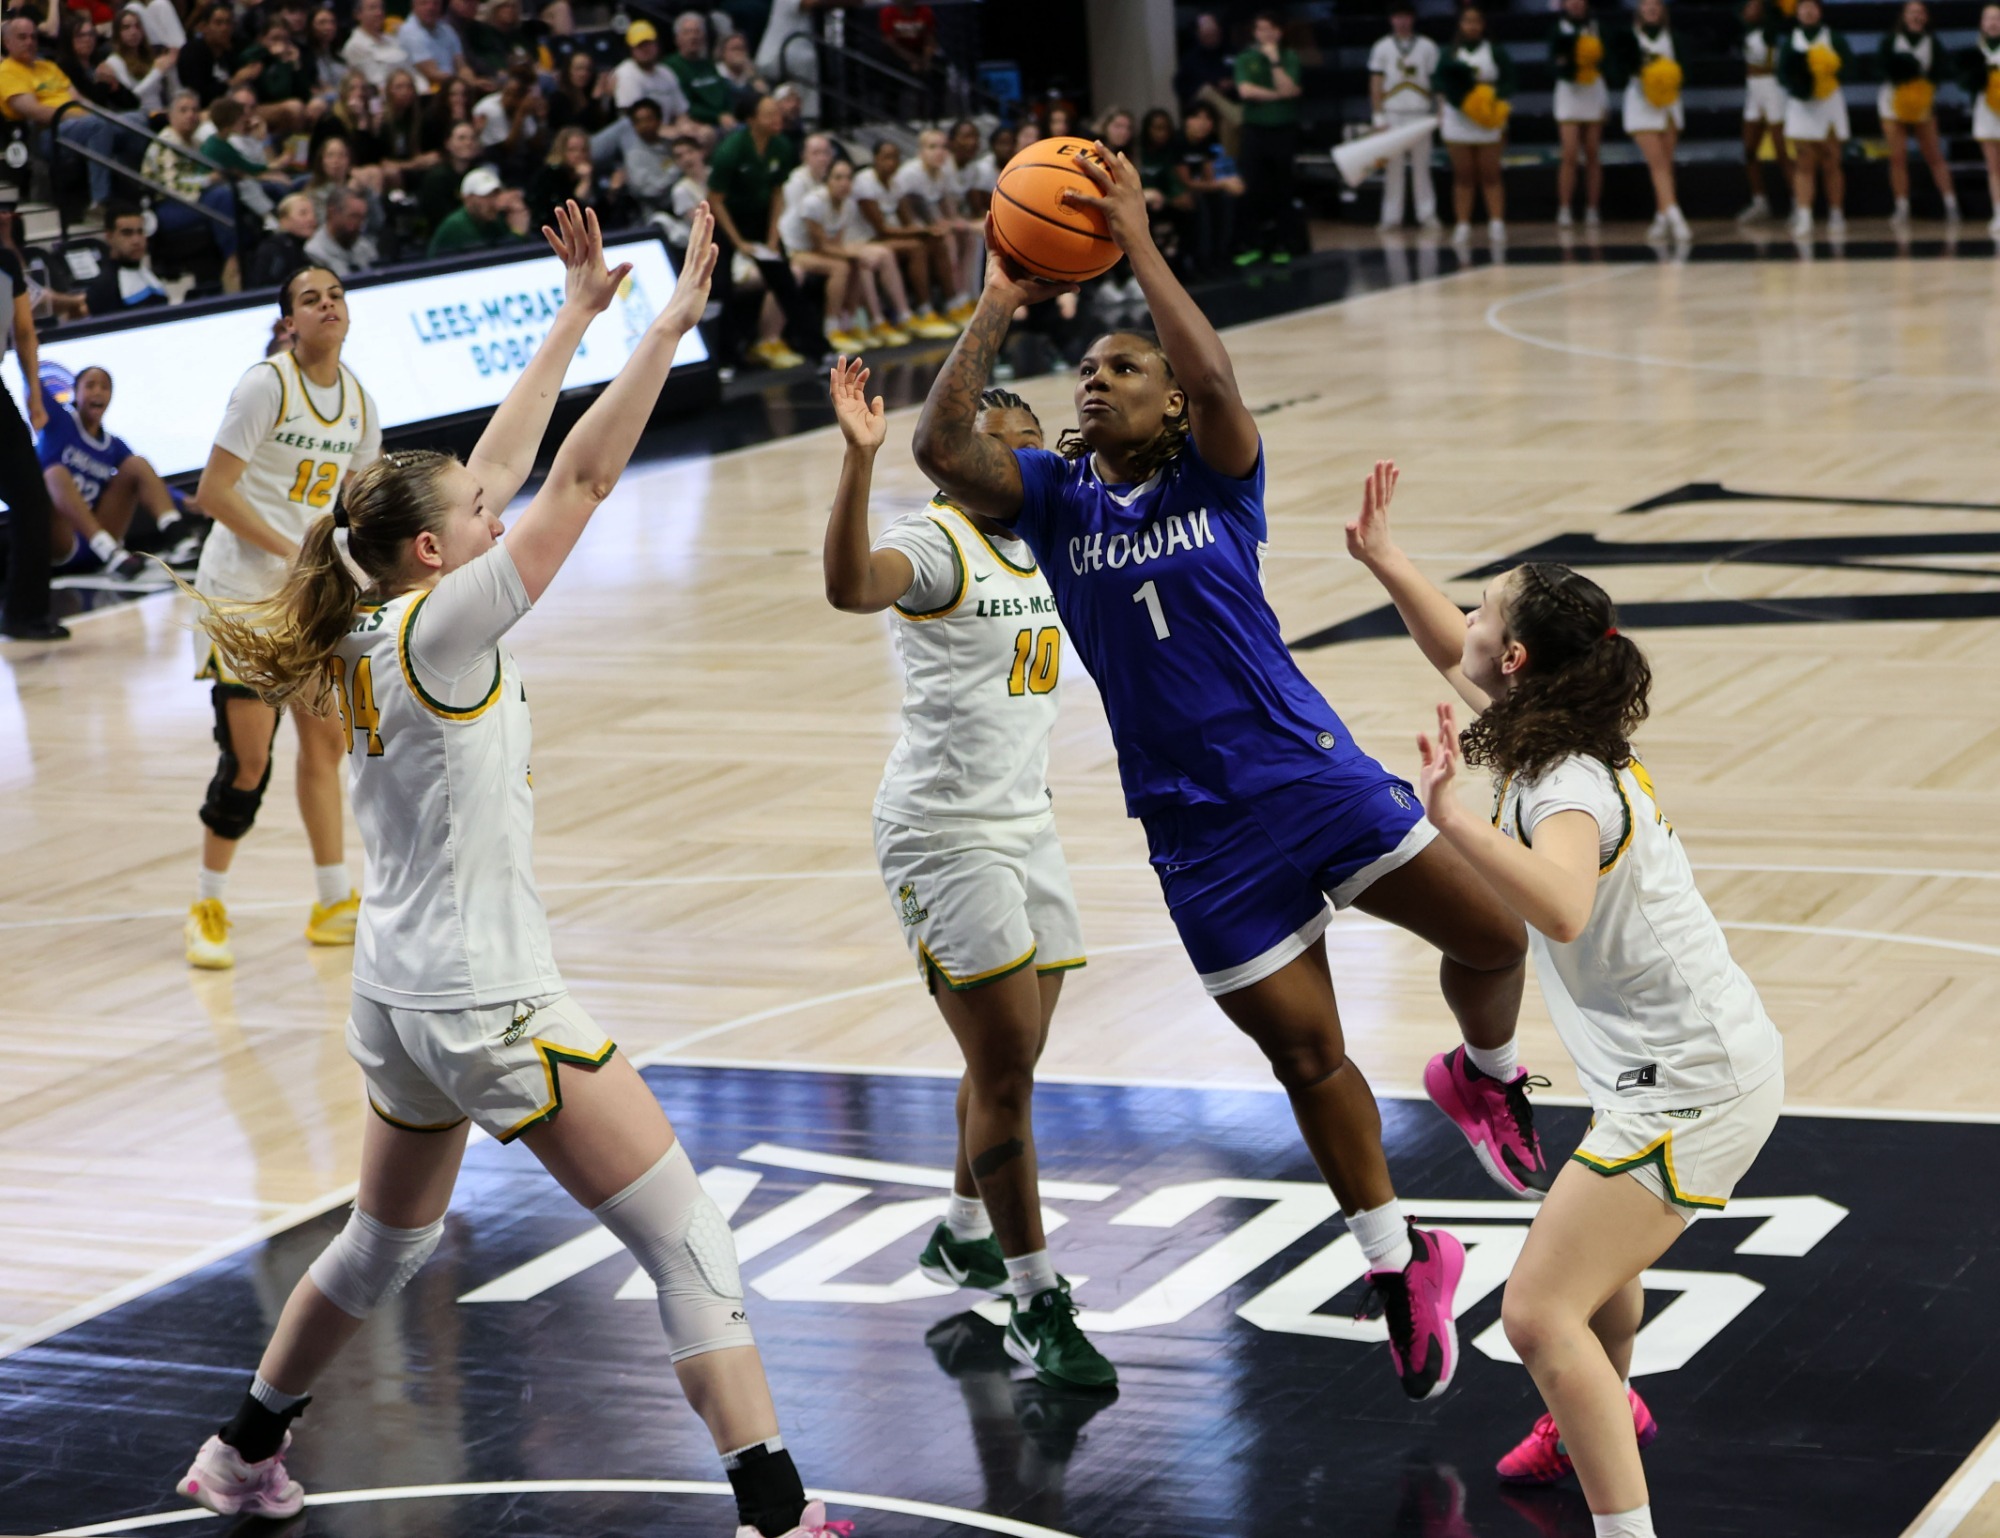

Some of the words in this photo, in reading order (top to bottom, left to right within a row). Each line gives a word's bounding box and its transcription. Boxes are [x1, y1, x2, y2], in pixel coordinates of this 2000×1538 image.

[288, 459, 339, 508] 12
[1068, 506, 1216, 576] CHOWAN
[1132, 579, 1171, 641] 1
[1007, 625, 1061, 697] 10
